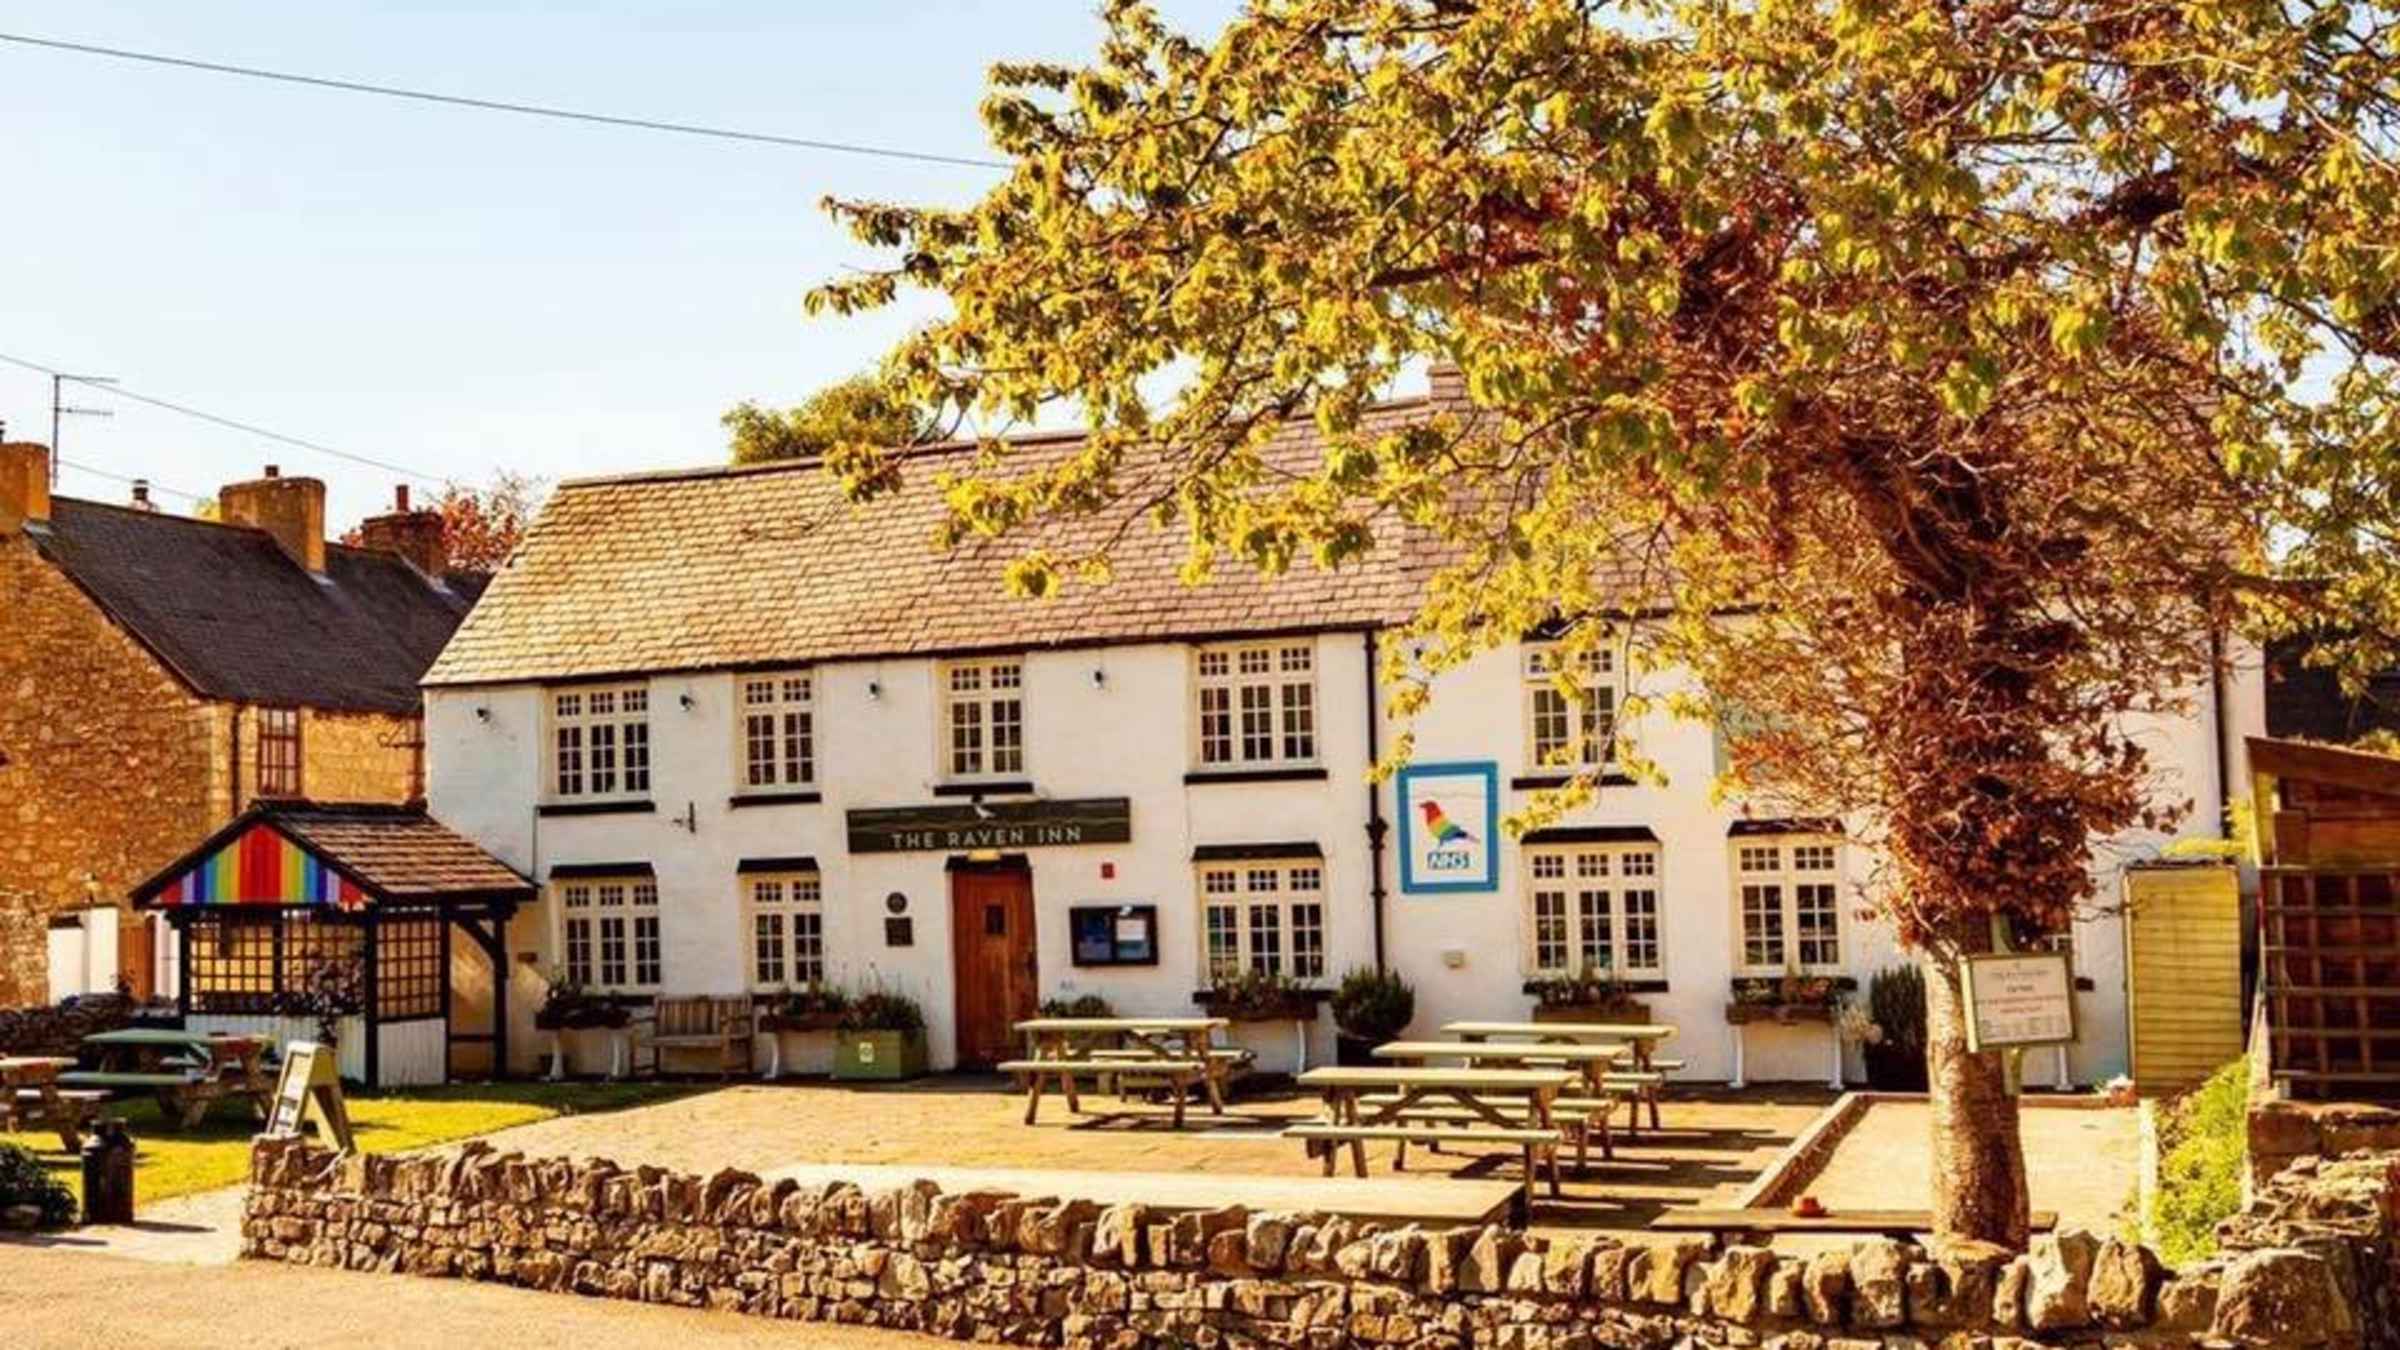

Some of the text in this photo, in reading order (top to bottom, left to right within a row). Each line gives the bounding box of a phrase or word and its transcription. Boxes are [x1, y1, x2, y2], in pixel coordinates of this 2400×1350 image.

[892, 825, 1081, 849] THE RAVEN INN
[1429, 853, 1467, 869] NHS
